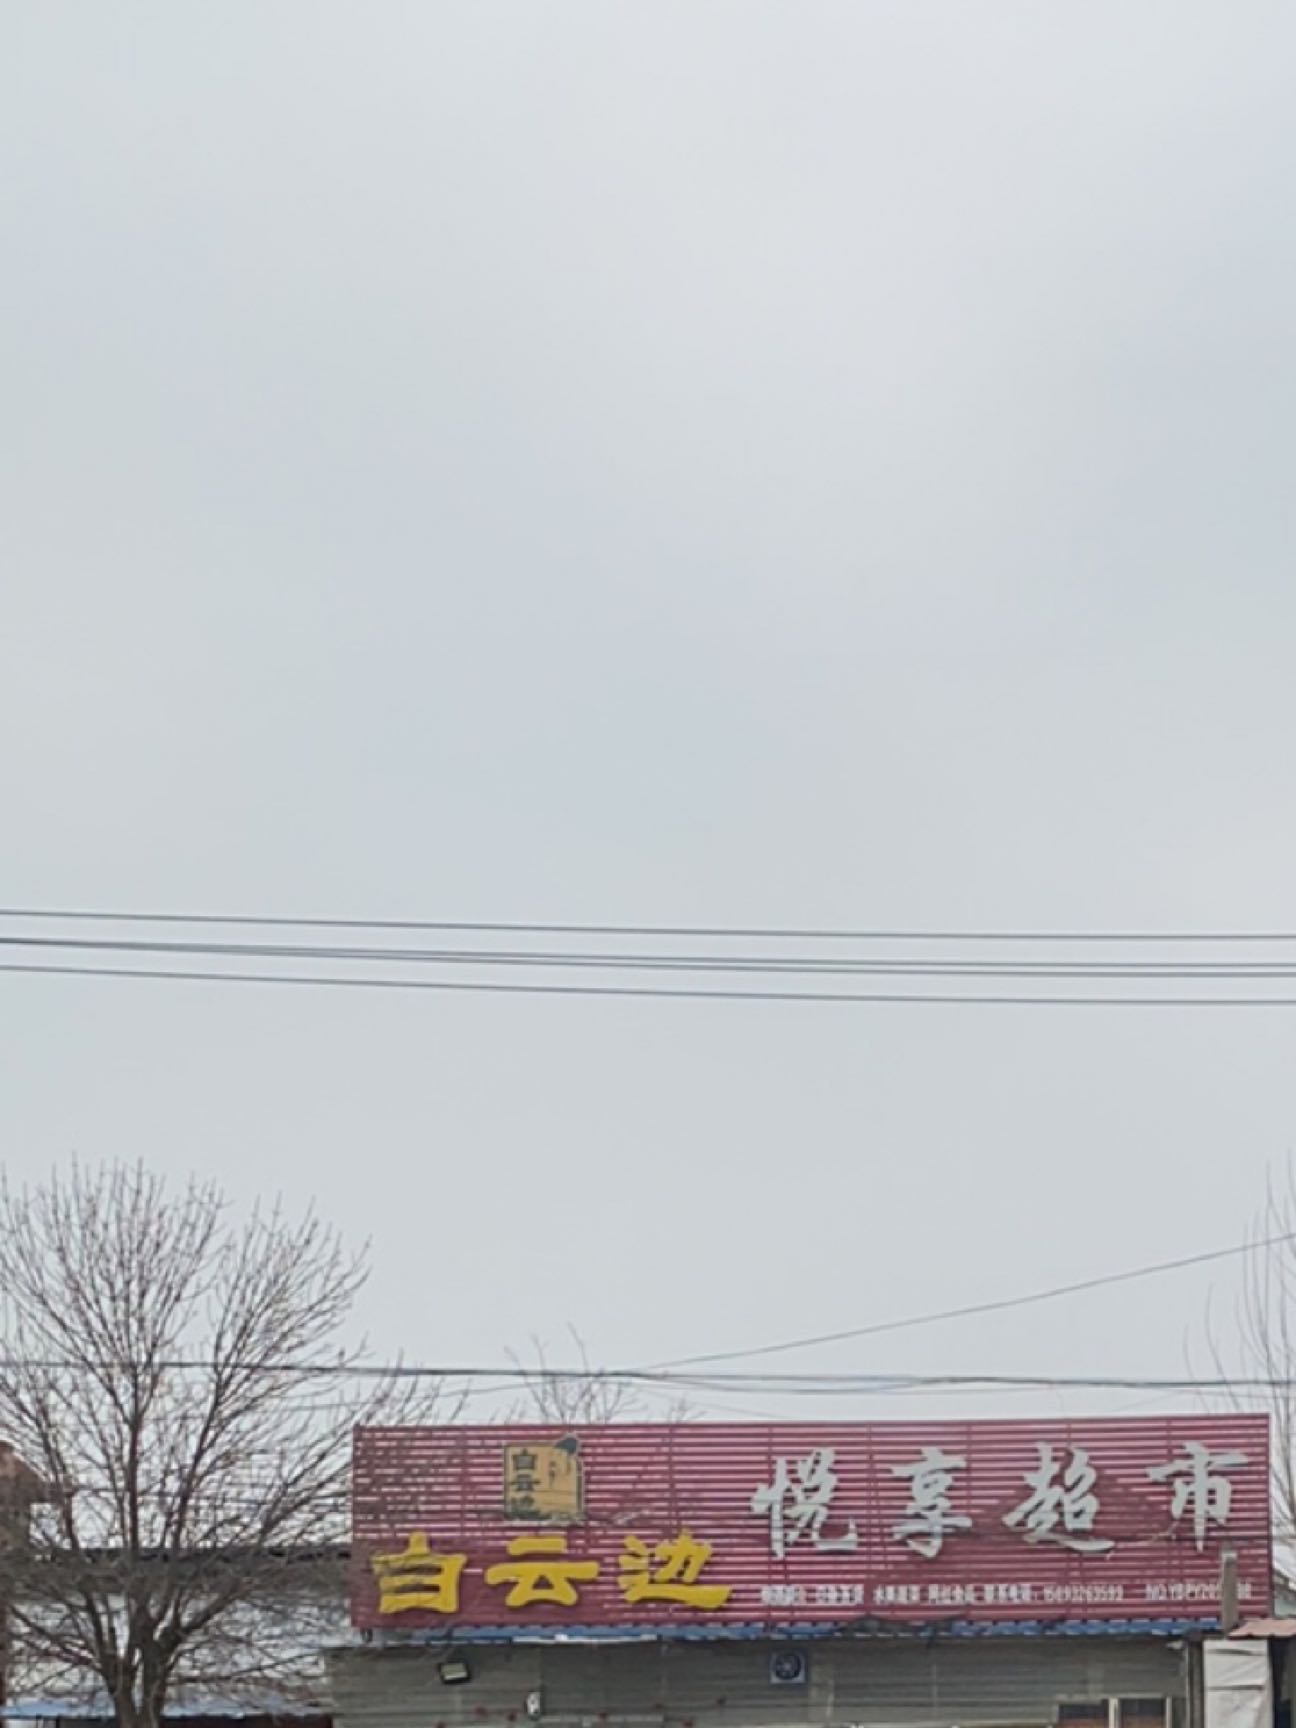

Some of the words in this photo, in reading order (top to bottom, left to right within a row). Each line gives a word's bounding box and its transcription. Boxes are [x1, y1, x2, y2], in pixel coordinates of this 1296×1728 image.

[749, 1441, 1250, 1559] 悦享超市
[370, 1528, 733, 1615] 白云边
